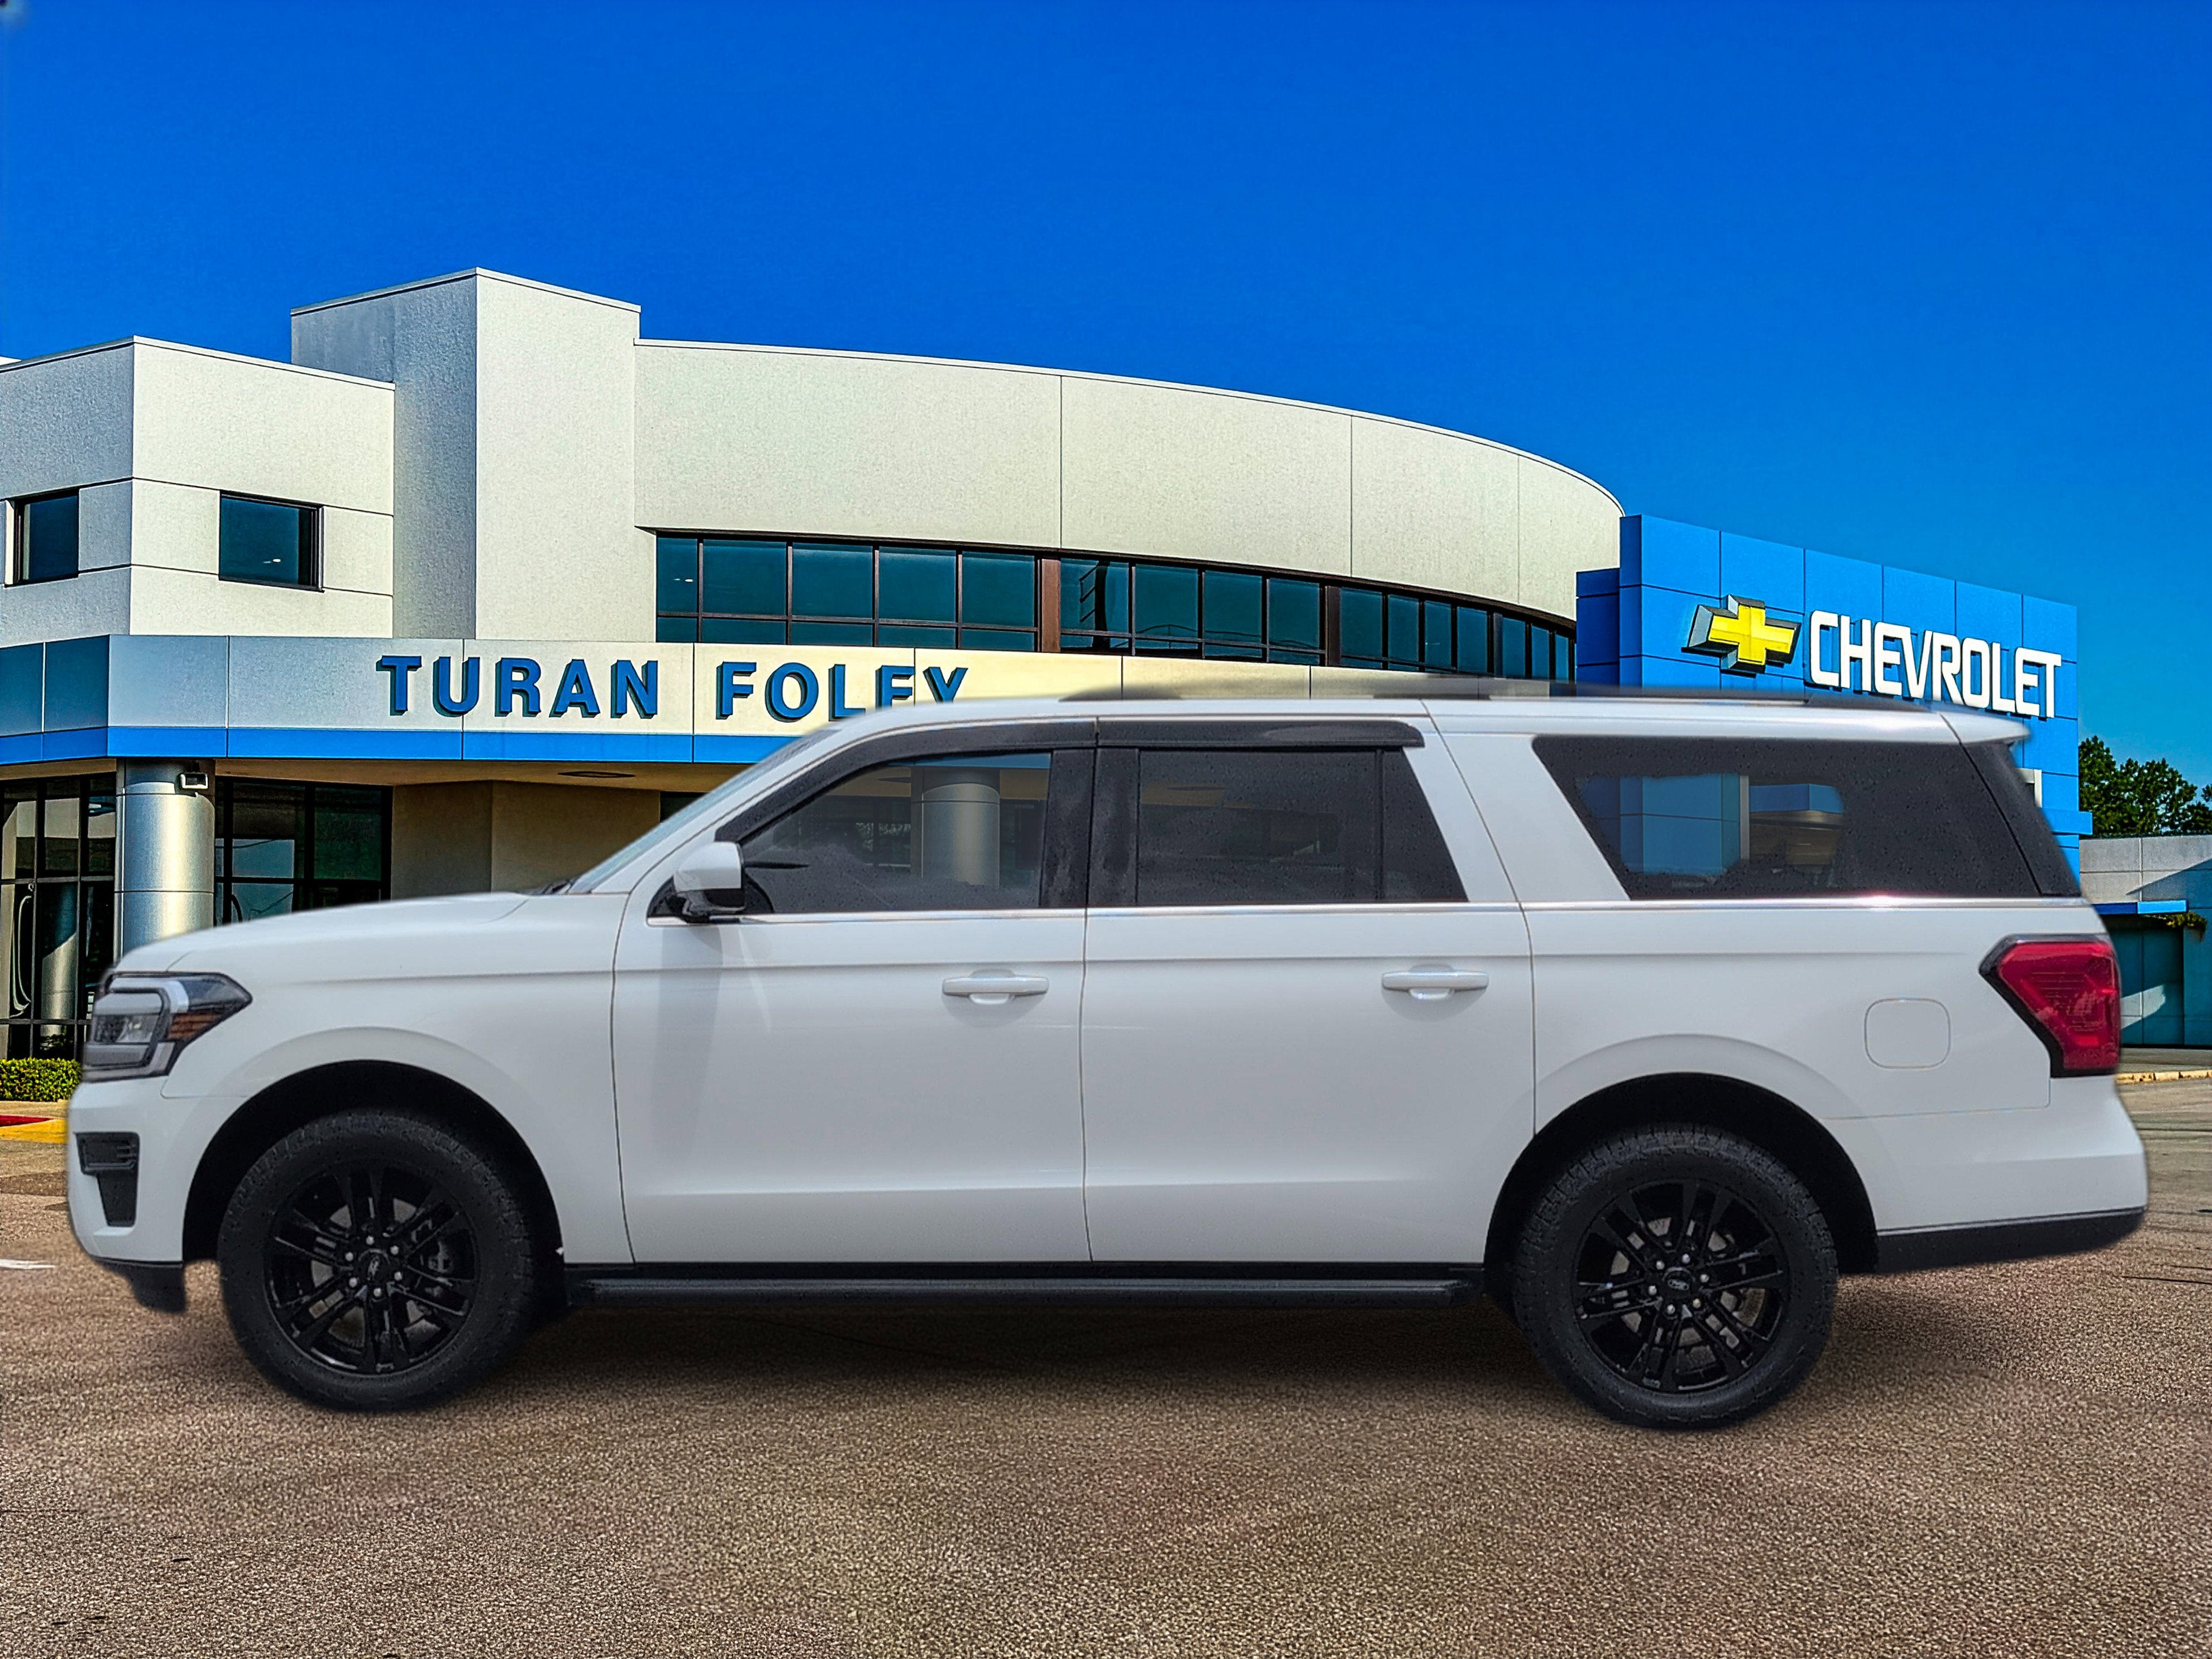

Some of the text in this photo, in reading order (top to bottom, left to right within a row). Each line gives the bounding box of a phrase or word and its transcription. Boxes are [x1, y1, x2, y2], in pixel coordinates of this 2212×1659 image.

[376, 655, 969, 722] TURAN FOLEY
[1809, 610, 2062, 718] CHEVROLET
